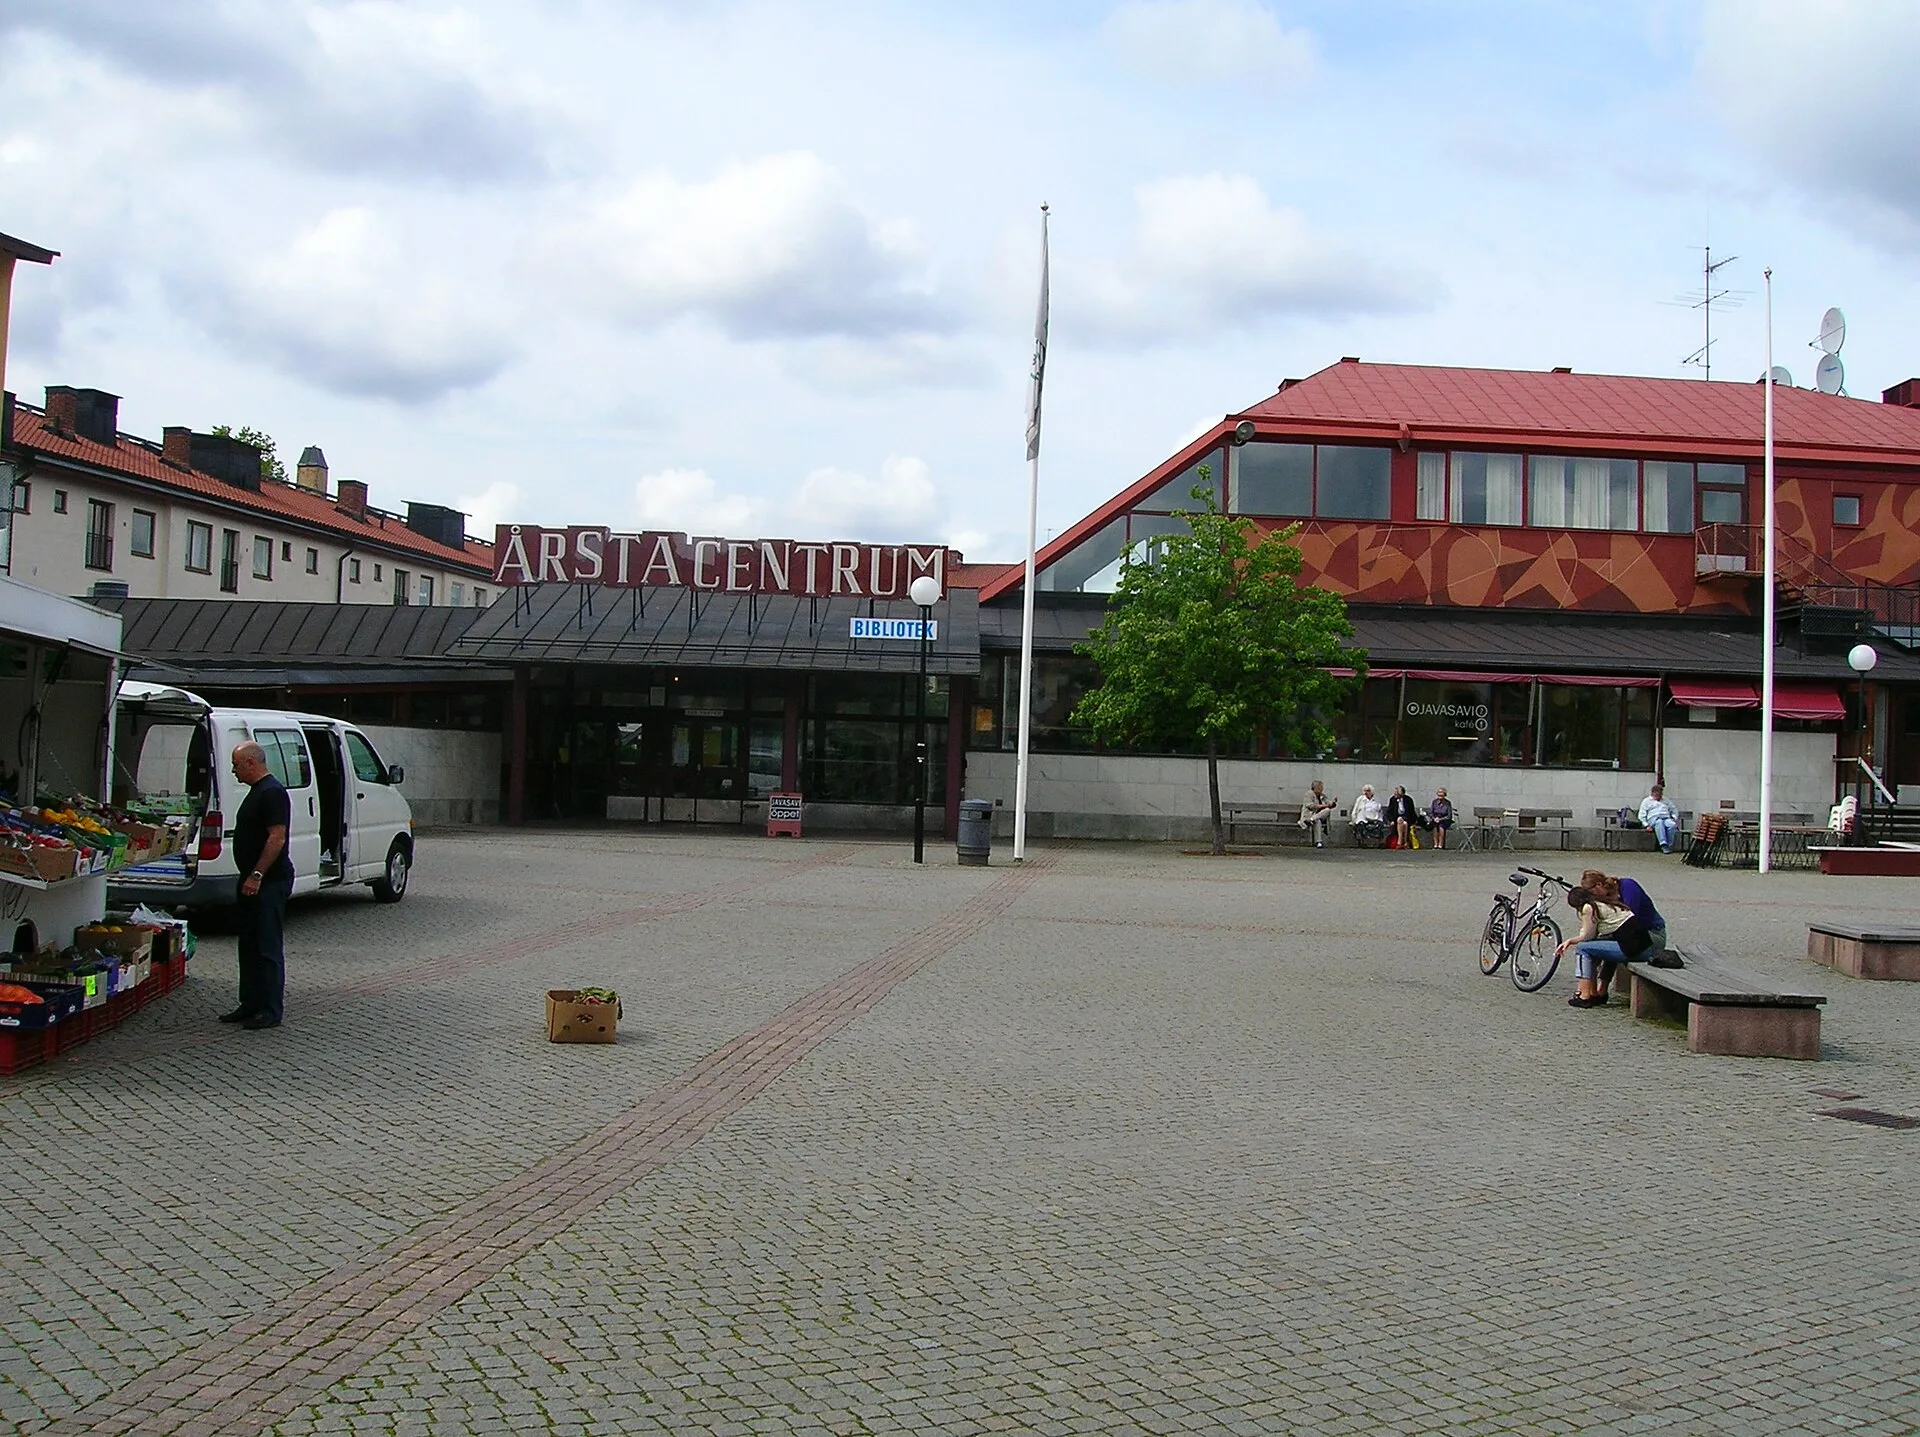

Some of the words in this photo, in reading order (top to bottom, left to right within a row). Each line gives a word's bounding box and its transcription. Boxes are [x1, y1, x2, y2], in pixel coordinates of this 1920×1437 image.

[495, 525, 682, 584] ÅRSTA
[693, 540, 945, 598] CENTRUM
[854, 620, 934, 638] BIBLIOTEK
[1420, 704, 1475, 716] JAVASAVI
